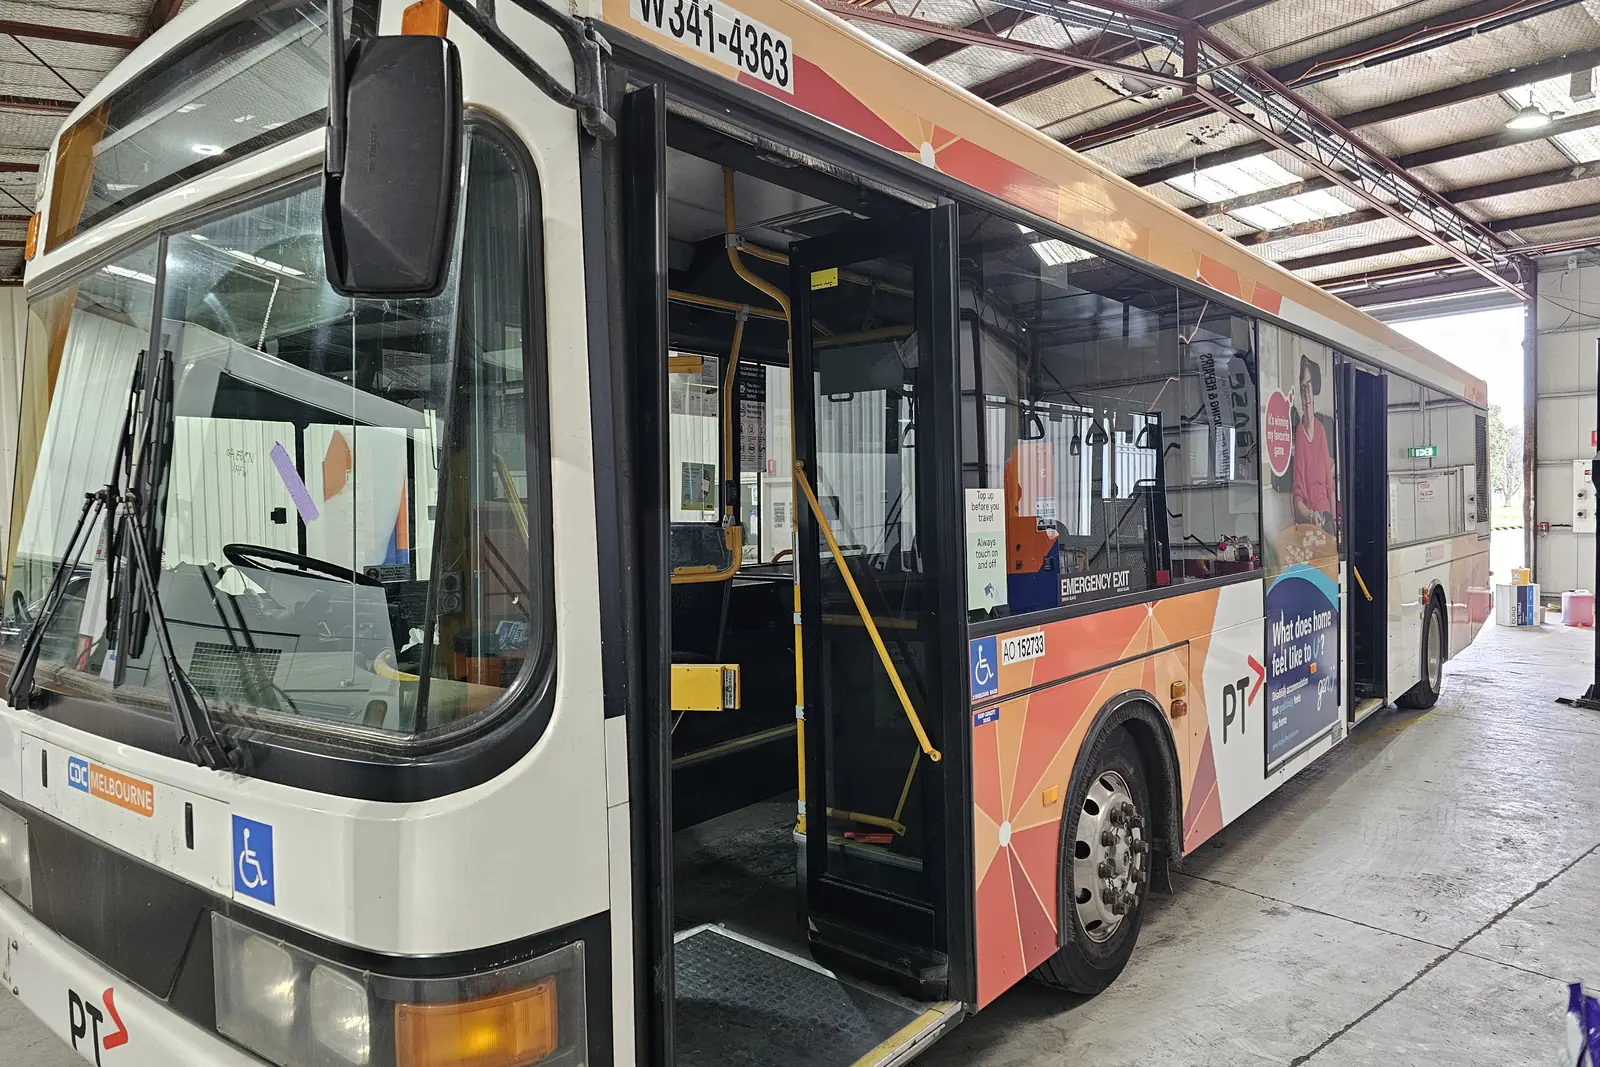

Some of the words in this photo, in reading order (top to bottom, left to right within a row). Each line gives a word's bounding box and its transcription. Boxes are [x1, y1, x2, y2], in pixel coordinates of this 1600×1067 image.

[977, 490, 986, 501] Top
[988, 493, 994, 501] up
[971, 502, 990, 511] before
[990, 503, 1000, 512] you
[978, 513, 994, 522] travel
[977, 538, 996, 549] Always
[976, 550, 990, 558] touch
[977, 562, 988, 570] and
[988, 559, 997, 569] off
[1061, 573, 1112, 596] EMERGENCY
[1113, 570, 1130, 587] EXIT
[1272, 613, 1294, 646] What
[1295, 615, 1312, 638] does
[1313, 610, 1331, 632] home
[1004, 642, 1015, 661] AO
[1018, 635, 1044, 657] 152733
[1272, 648, 1287, 677] feel
[1289, 645, 1302, 670] like
[1304, 643, 1312, 663] to
[69, 762, 88, 786] CDC
[90, 770, 152, 810] MELBOURNE
